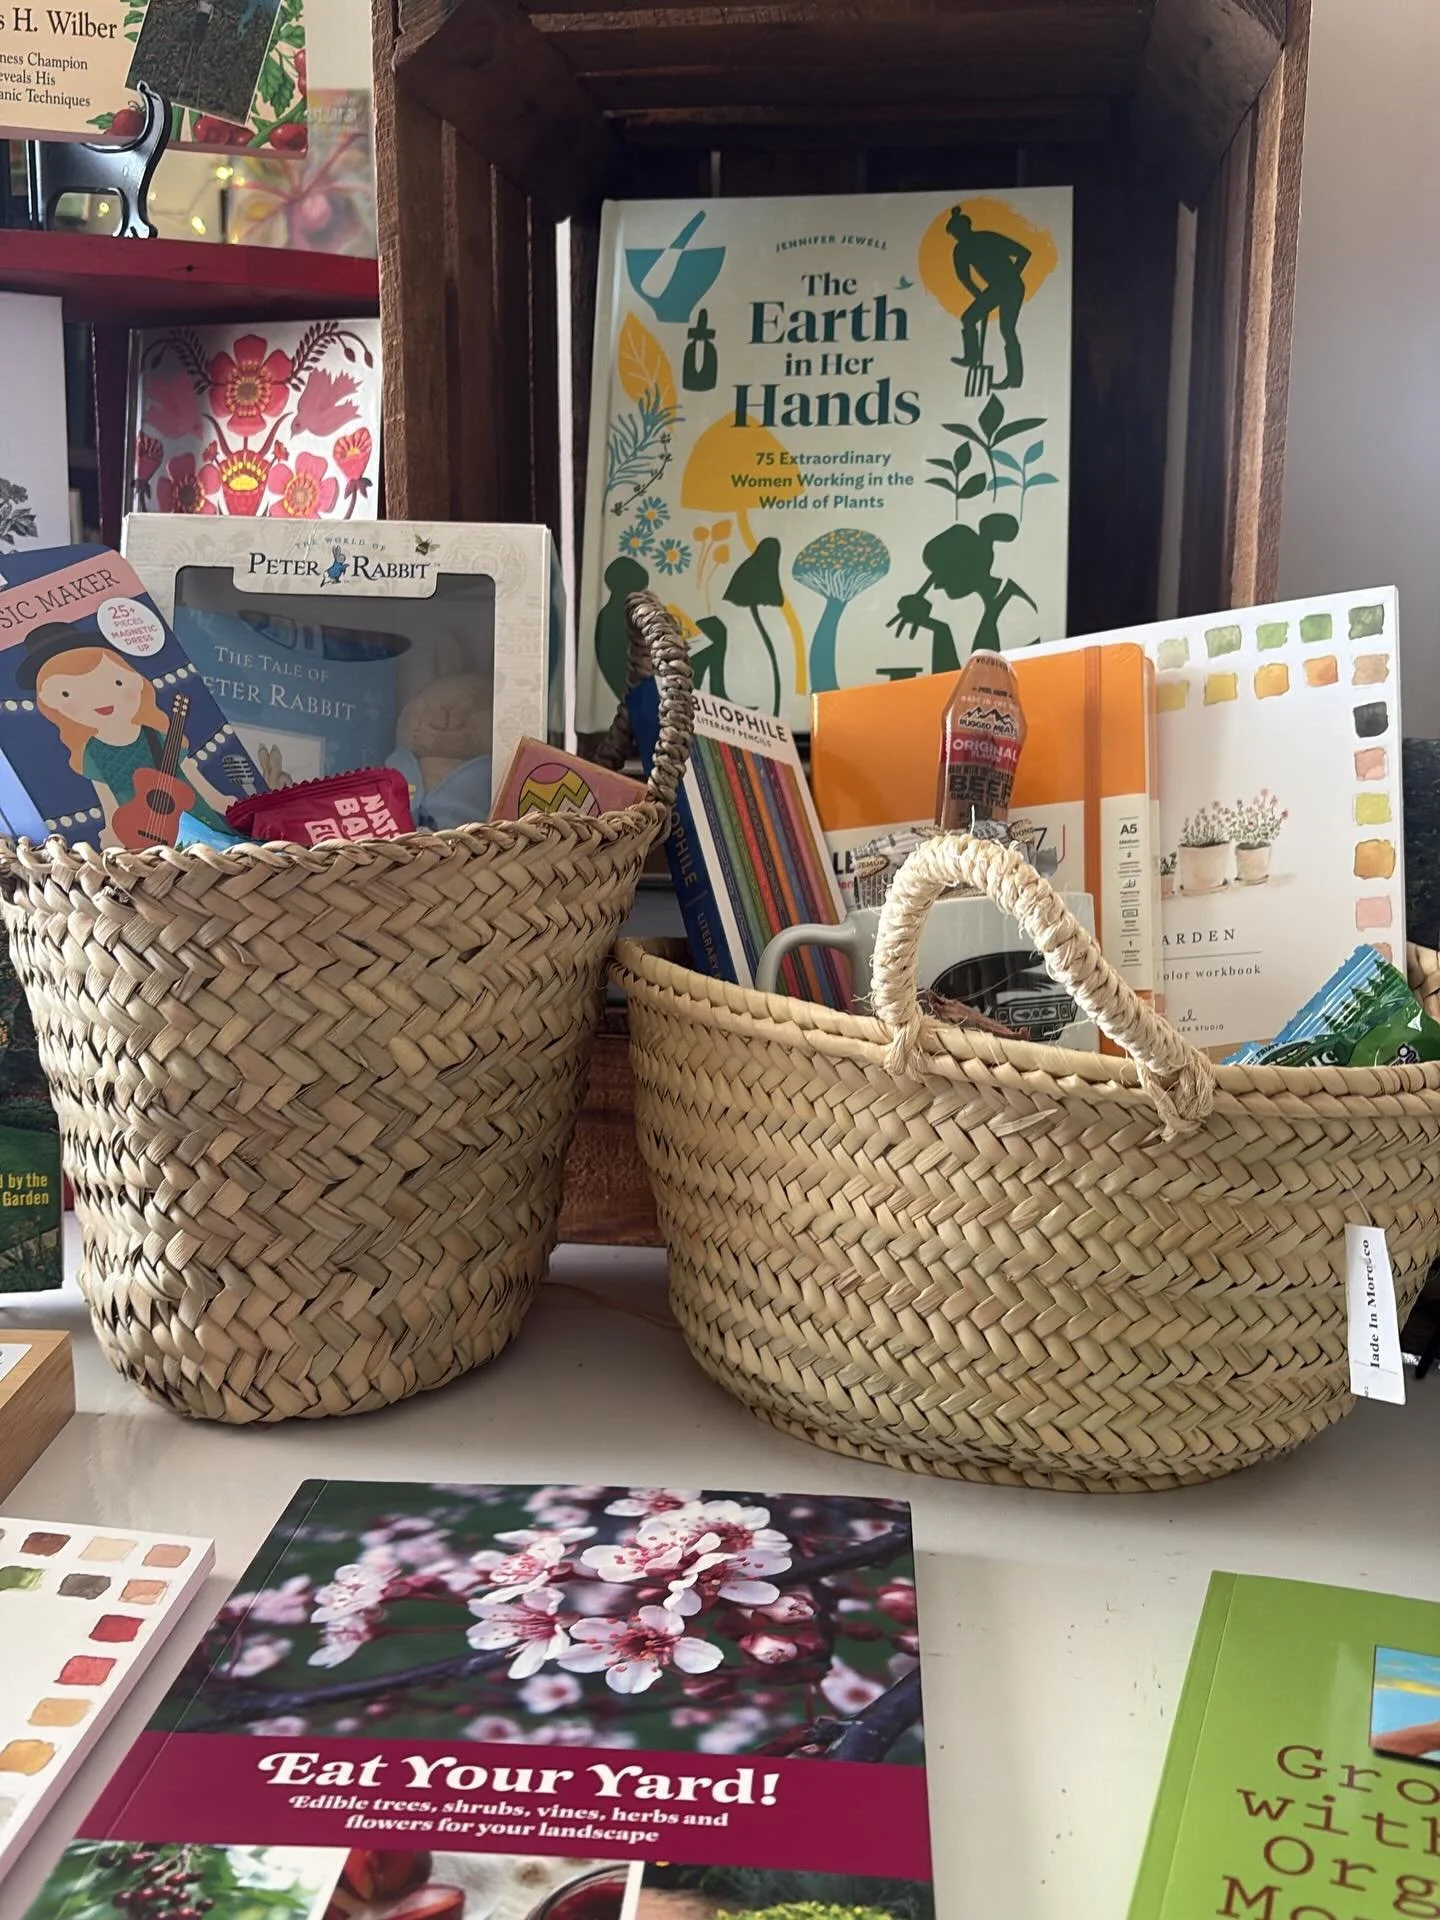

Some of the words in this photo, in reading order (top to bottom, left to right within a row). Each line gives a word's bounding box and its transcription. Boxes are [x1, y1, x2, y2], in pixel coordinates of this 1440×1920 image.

[12, 7, 38, 32] H.
[46, 10, 117, 39] Wilber
[27, 51, 88, 71] Champion
[36, 71, 56, 85] His
[25, 88, 91, 109] Techniques
[776, 235, 836, 253] JENNIFER
[842, 235, 888, 250] JEWELL
[801, 272, 857, 296] The
[748, 294, 910, 345] Earth
[785, 352, 812, 376] in
[820, 353, 874, 376] Her
[731, 377, 921, 428] Hands
[756, 452, 775, 466] 75
[780, 450, 892, 467] Extraordinary
[731, 474, 793, 488] Women
[797, 472, 865, 490] Working
[868, 472, 883, 486] in
[887, 471, 914, 486] the
[759, 496, 808, 510] World
[812, 495, 830, 509] of
[833, 495, 885, 509] Plants
[325, 537, 366, 546] WORLD
[35, 568, 121, 614] MAKER
[108, 604, 136, 620] 25+
[111, 625, 158, 639] MAGNETIC
[114, 618, 144, 628] PIECES
[124, 636, 154, 646] DRESS
[136, 644, 151, 652] UP
[308, 668, 329, 683] OF
[697, 716, 736, 735] LITERARY
[738, 730, 772, 748] PENCILS
[952, 738, 1018, 763] ORIGINAL
[1120, 823, 1138, 836] A5
[1195, 963, 1262, 978] workbook
[1195, 1023, 1223, 1032] STUDIO
[8, 1173, 24, 1190] by
[26, 1172, 48, 1188] the
[3, 1190, 49, 1207] Garden
[257, 1752, 388, 1787] Eat
[401, 1755, 574, 1795] Your
[586, 1763, 780, 1806] Yard!
[288, 1795, 370, 1811] Edible
[373, 1798, 438, 1814] trees,
[442, 1799, 531, 1818] shrubs,
[537, 1804, 606, 1822] vines,
[612, 1807, 680, 1825] herbs
[683, 1812, 729, 1827] and
[344, 1814, 433, 1832] flowers
[436, 1817, 475, 1833] for
[475, 1820, 536, 1838] your
[538, 1821, 660, 1844] landscape
